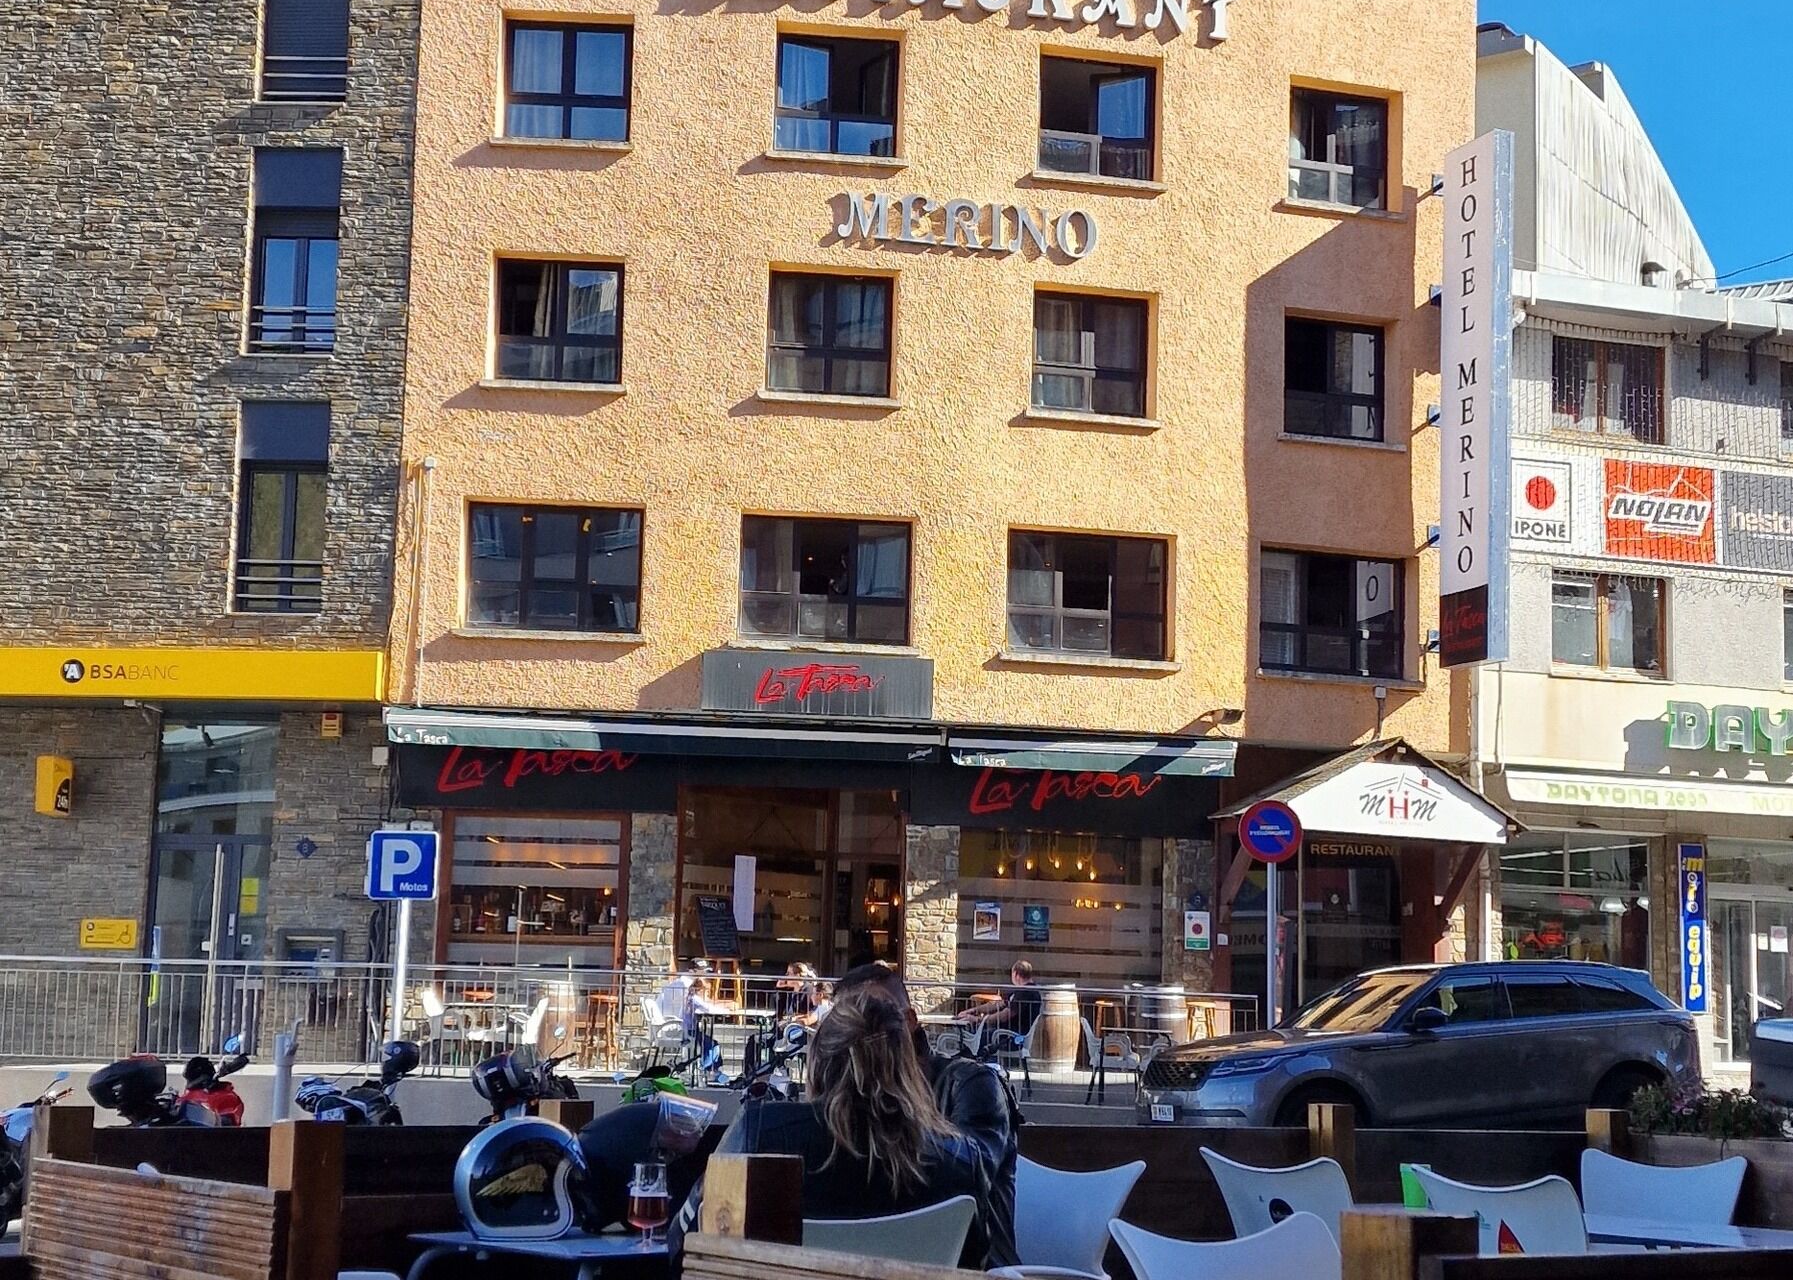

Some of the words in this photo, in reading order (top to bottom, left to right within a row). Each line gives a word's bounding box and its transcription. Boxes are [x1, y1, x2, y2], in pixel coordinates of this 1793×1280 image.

[838, 191, 1097, 259] MERINO
[1460, 155, 1478, 334] HOTEL
[1457, 357, 1478, 574] MERINO
[1514, 520, 1567, 539] IPONE
[1612, 497, 1708, 526] NOLAN
[90, 664, 180, 681] BSABANC
[755, 668, 797, 704] La
[777, 663, 886, 702] Tasca
[397, 727, 412, 743] La
[437, 747, 503, 793] La
[968, 767, 1030, 814] La
[1546, 782, 1659, 807] DAYTONA
[380, 839, 422, 891] P
